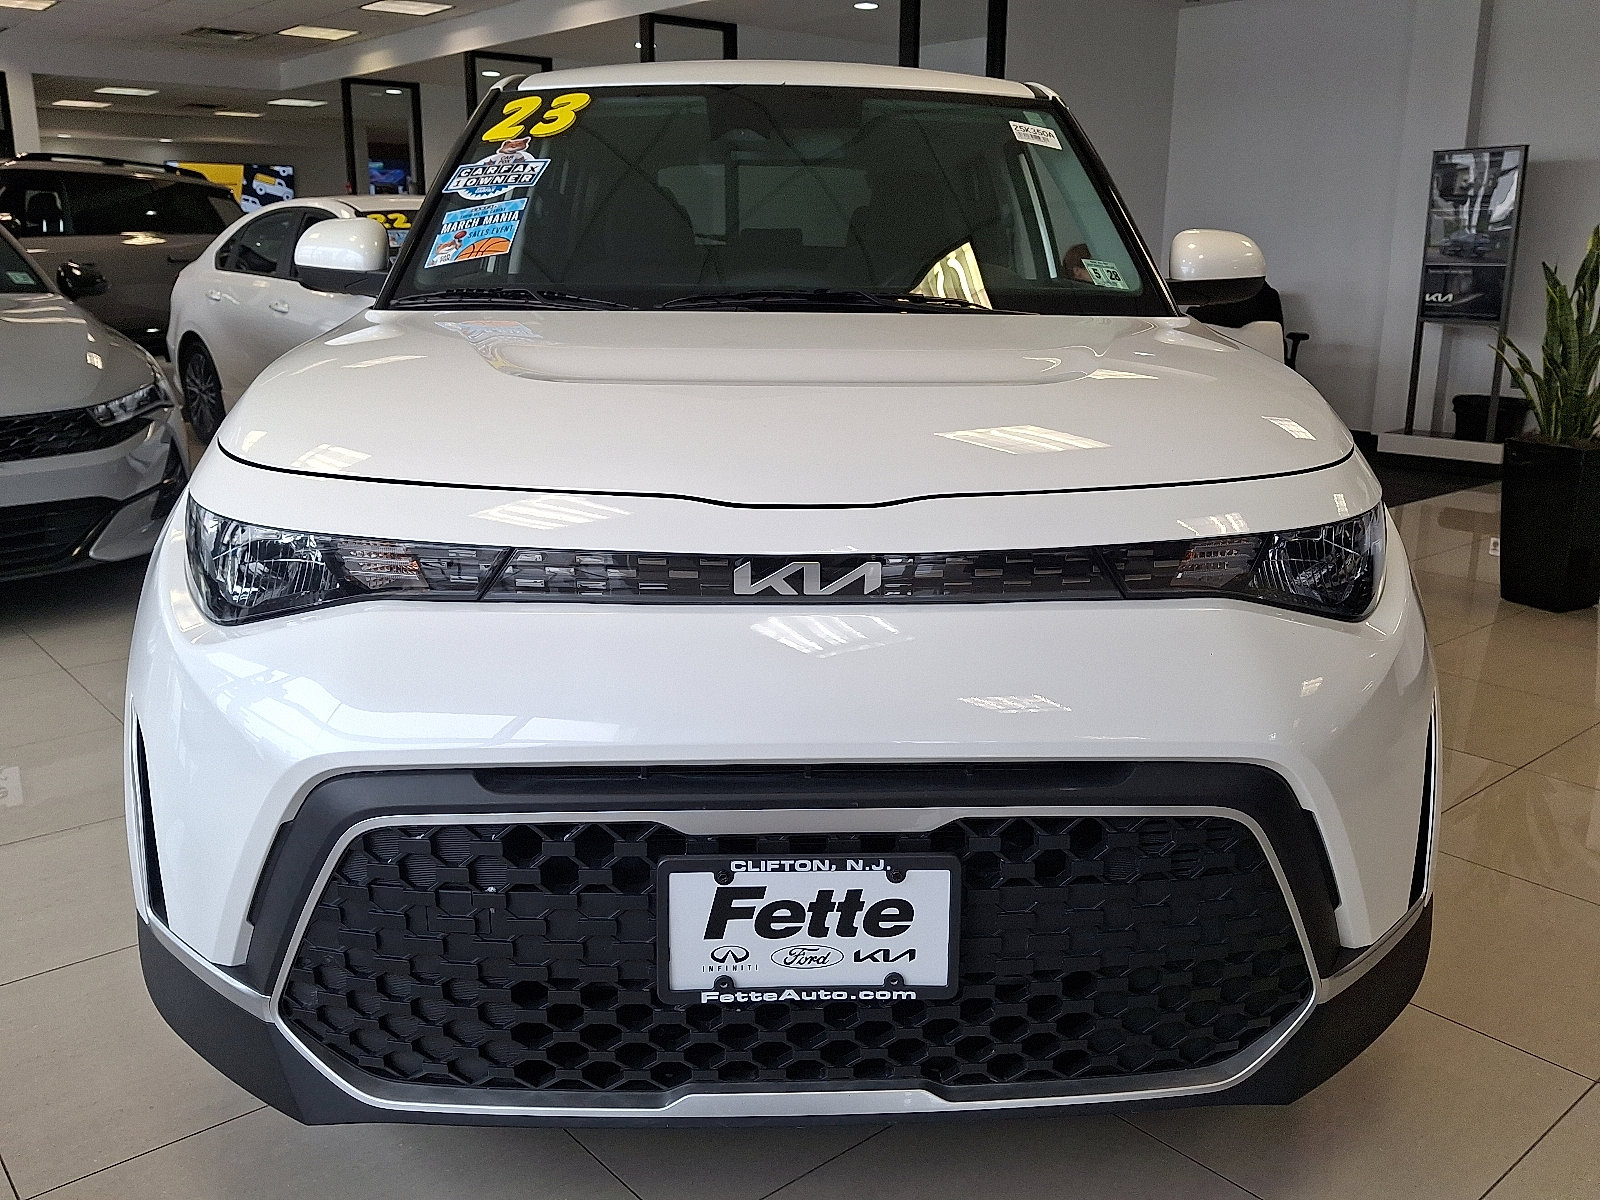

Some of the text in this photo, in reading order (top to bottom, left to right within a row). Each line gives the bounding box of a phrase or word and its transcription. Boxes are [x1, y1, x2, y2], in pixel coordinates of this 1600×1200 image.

[482, 92, 591, 142] 23
[460, 163, 538, 177] CARFAX
[466, 174, 533, 186] OWNER
[441, 217, 480, 234] MARCH
[483, 210, 520, 225] MANIA
[467, 225, 514, 239] SALES EVENT
[1091, 267, 1121, 282] 5 28
[1425, 292, 1454, 302] KIA
[733, 560, 882, 596] KIA
[730, 859, 892, 872] CLIFTON, N.J.
[703, 885, 915, 941] Fette
[783, 947, 832, 967] Ford
[853, 948, 917, 963] KIA
[701, 963, 759, 973] INFINITI
[700, 988, 917, 1004] FetteAuto.com
